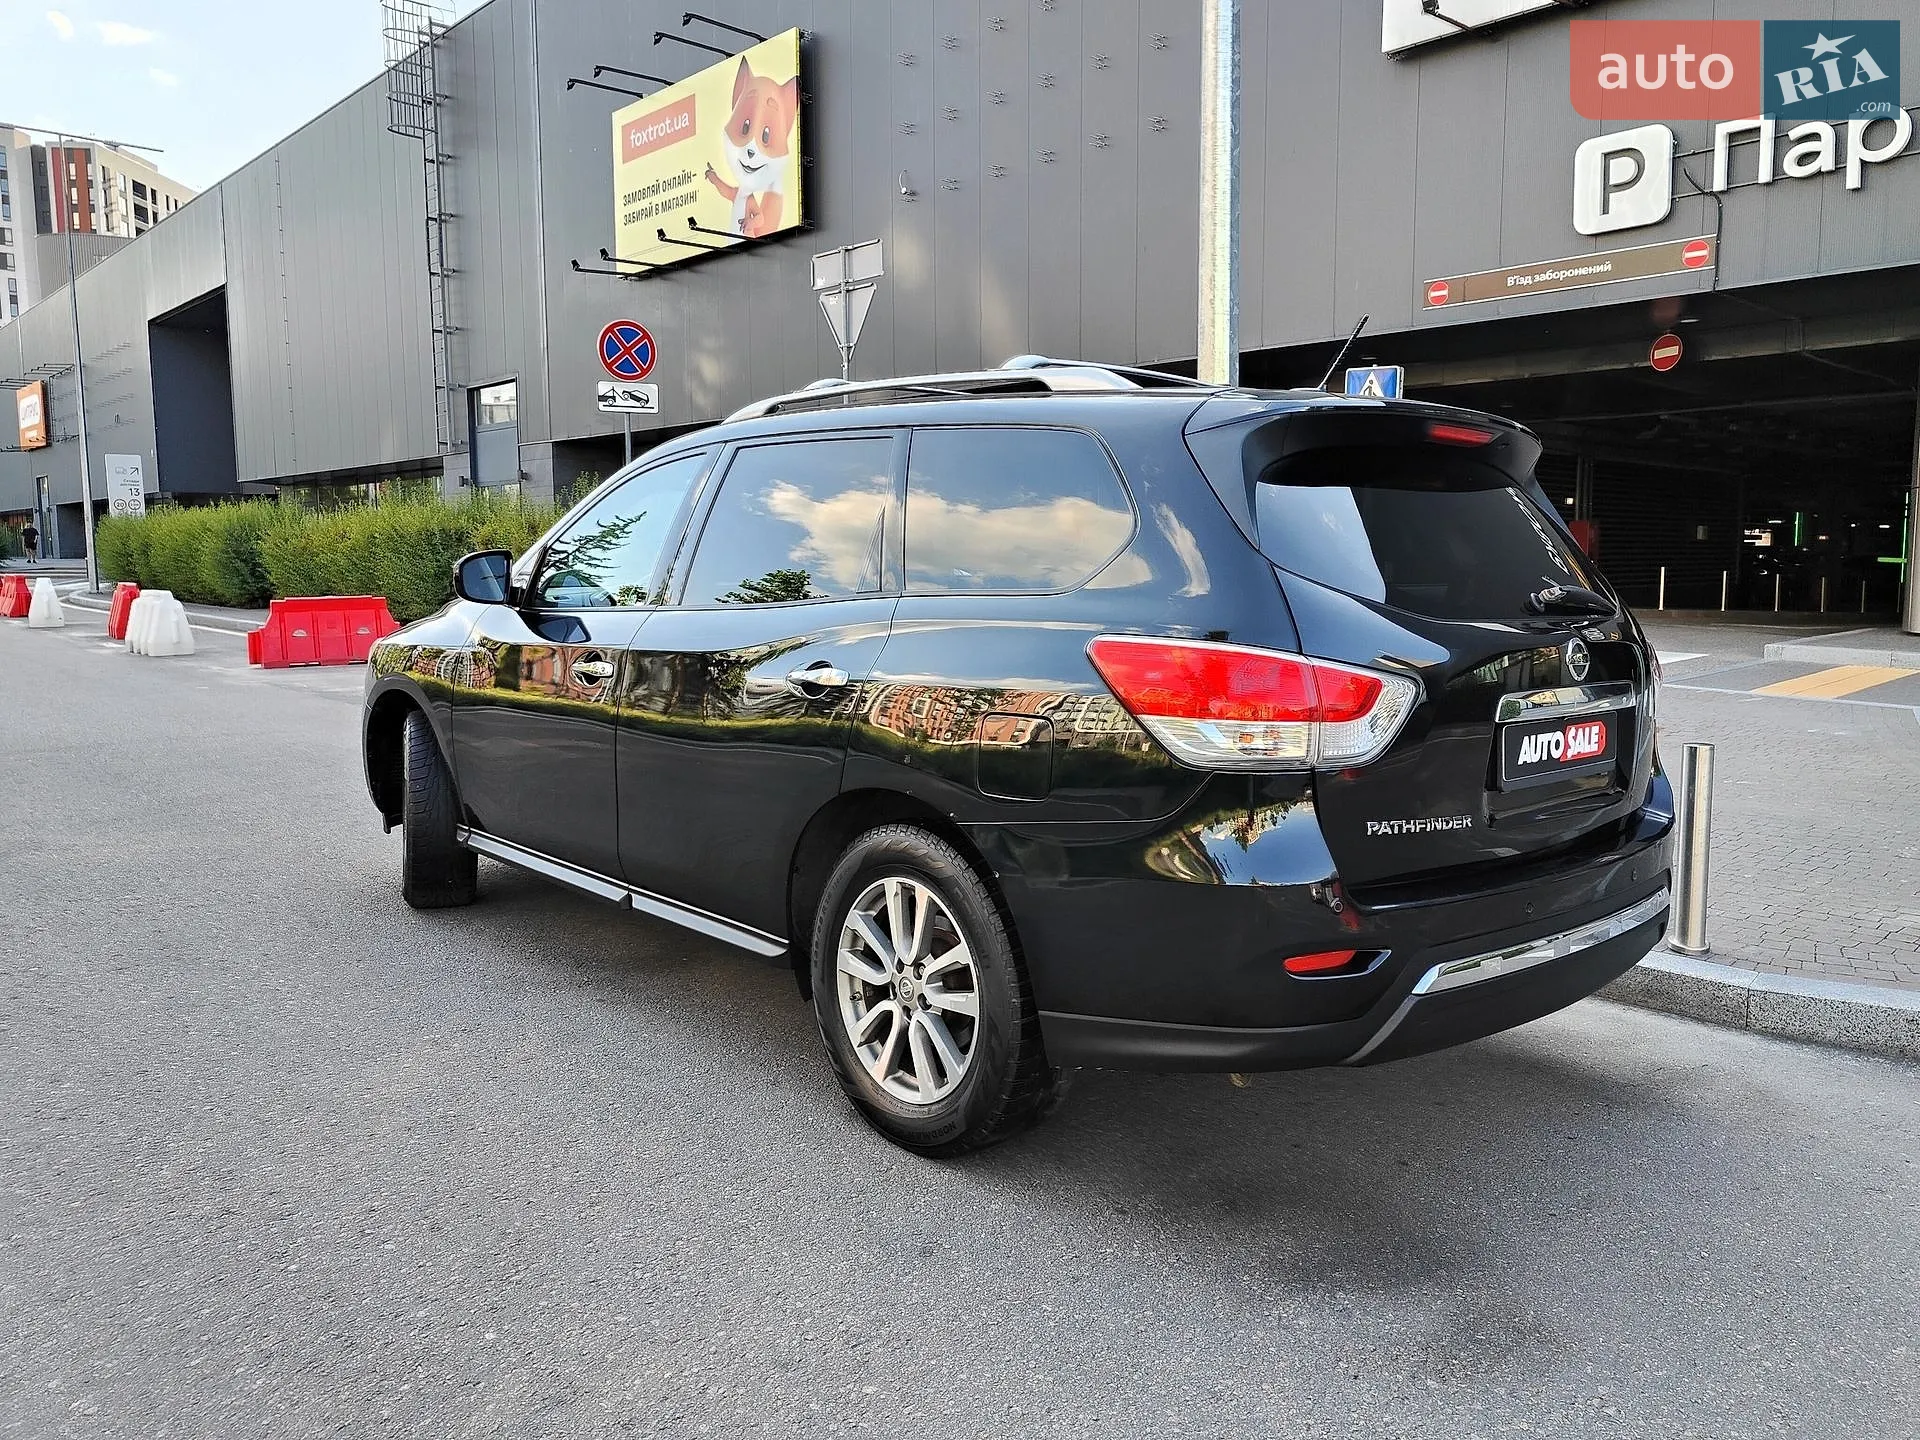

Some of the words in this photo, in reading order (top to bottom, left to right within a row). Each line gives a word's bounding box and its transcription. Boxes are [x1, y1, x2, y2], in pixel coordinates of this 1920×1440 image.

[630, 112, 690, 149] foxtrot.ua
[623, 179, 660, 207] ЗАМОВЛЯЙ
[623, 202, 654, 226] ЗАБИРАЙ
[1533, 260, 1612, 281] заборонений
[128, 487, 140, 496] 13
[1517, 730, 1565, 765] AUTO
[1366, 815, 1473, 836] PATHFINDER
